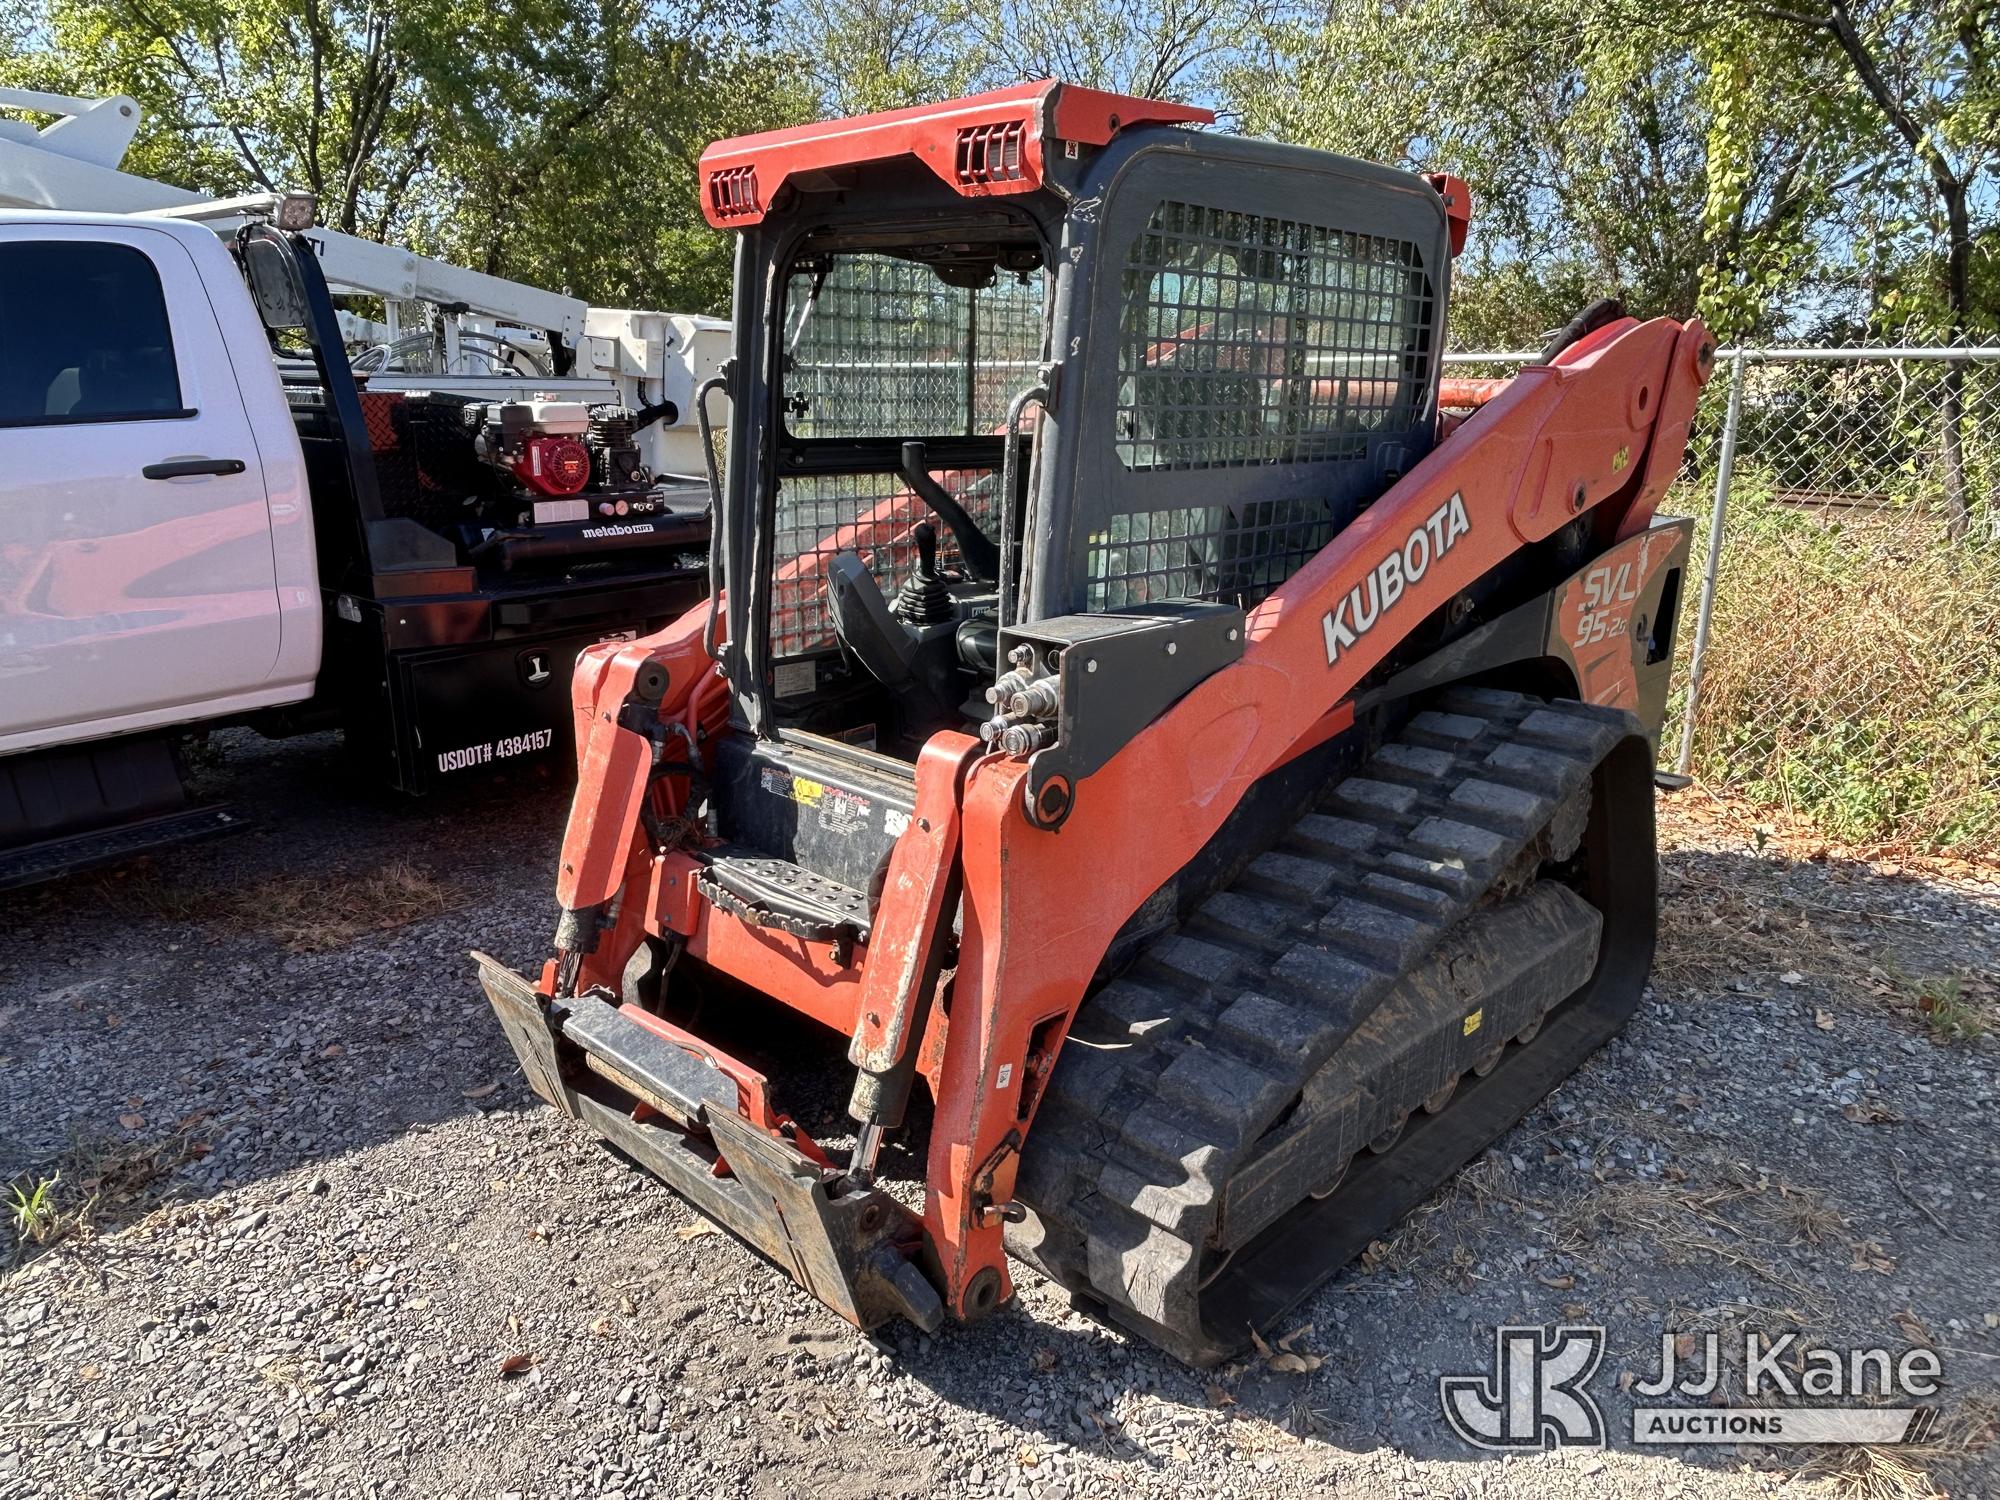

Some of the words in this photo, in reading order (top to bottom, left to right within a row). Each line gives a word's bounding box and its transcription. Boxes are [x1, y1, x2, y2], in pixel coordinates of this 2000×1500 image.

[583, 525, 633, 538] metabo
[1322, 492, 1470, 664] KUBOTA
[1578, 562, 1636, 612] SVL
[438, 742, 493, 773] USDOT#
[495, 728, 552, 759] 4384157
